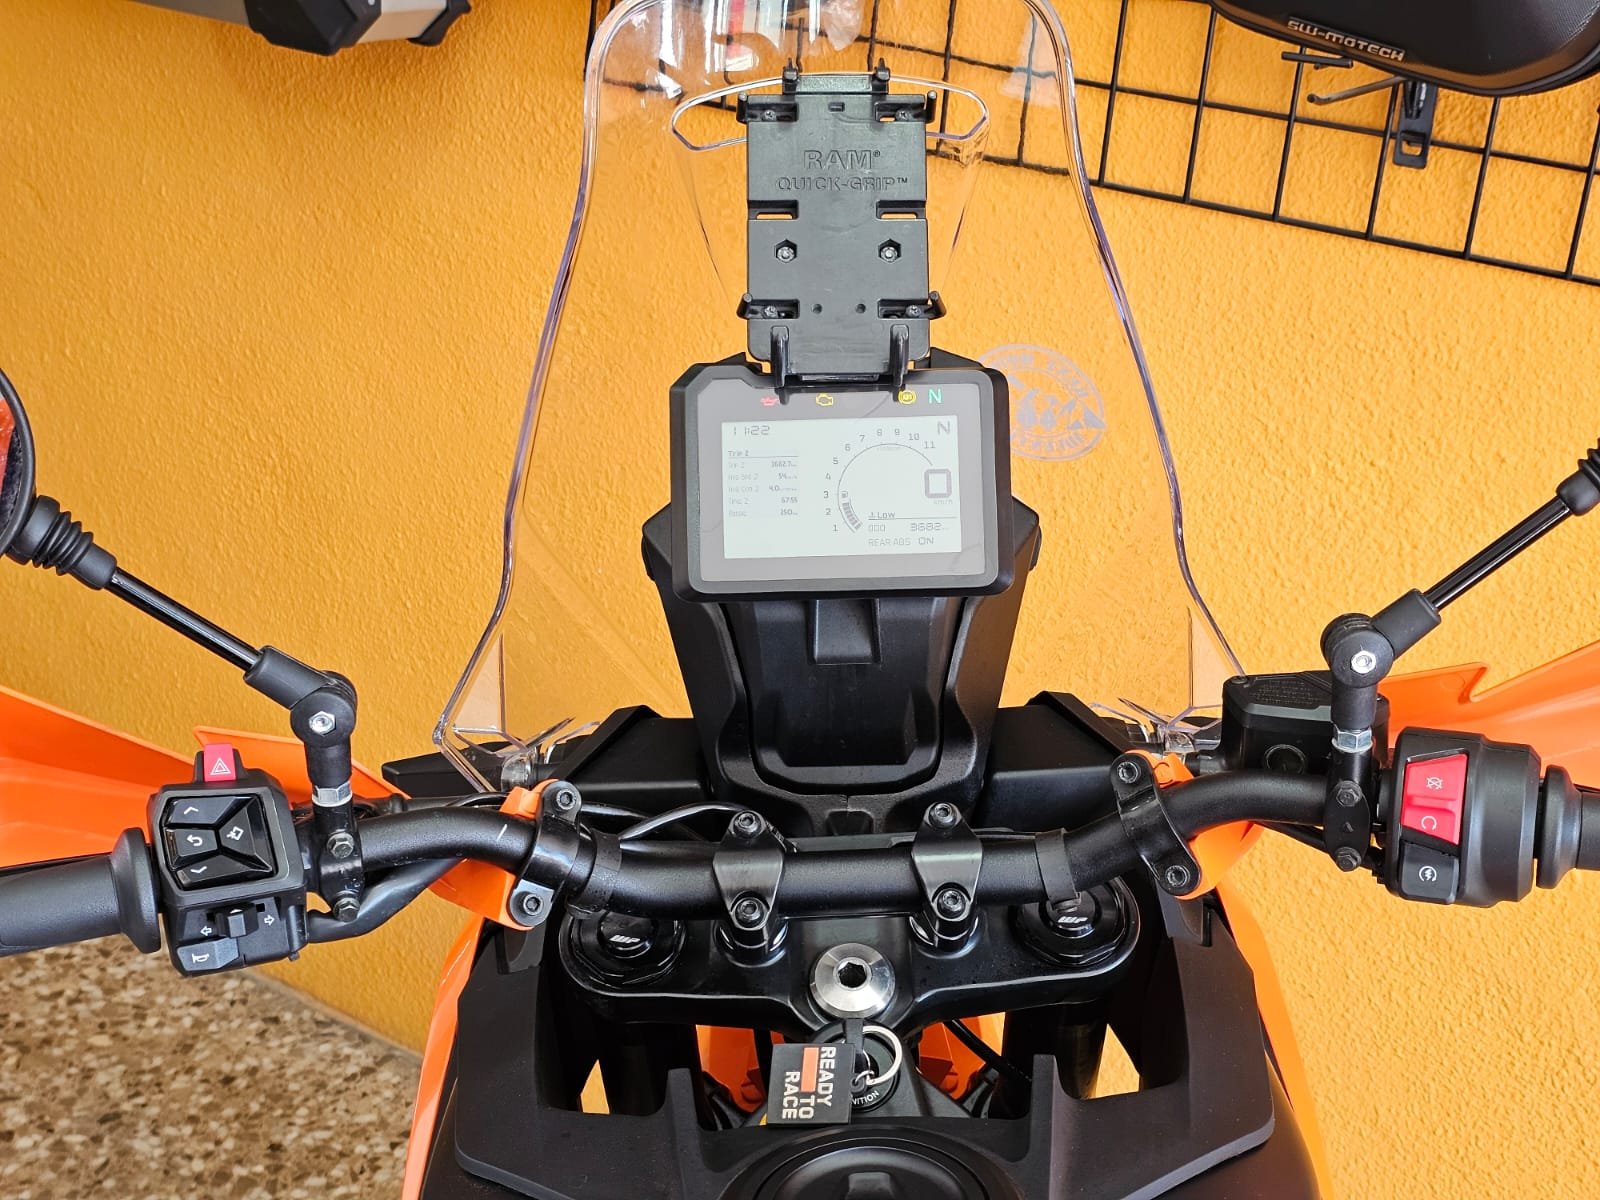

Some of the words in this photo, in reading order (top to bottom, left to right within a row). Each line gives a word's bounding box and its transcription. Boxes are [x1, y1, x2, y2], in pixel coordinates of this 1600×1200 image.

[1287, 20, 1405, 61] SW-MOTECH
[928, 388, 942, 404] N
[937, 420, 951, 435] N
[894, 428, 900, 436] 9
[859, 434, 865, 442] 7
[908, 433, 920, 441] 10
[844, 443, 851, 451] 6
[923, 441, 936, 449] 11
[832, 457, 839, 465] 5
[823, 490, 829, 499] 3
[825, 508, 831, 516] 2
[832, 524, 839, 532] 1
[918, 536, 935, 546] ON
[816, 1046, 837, 1107] READY
[781, 1071, 801, 1120] RACE
[798, 1094, 816, 1119] TO
